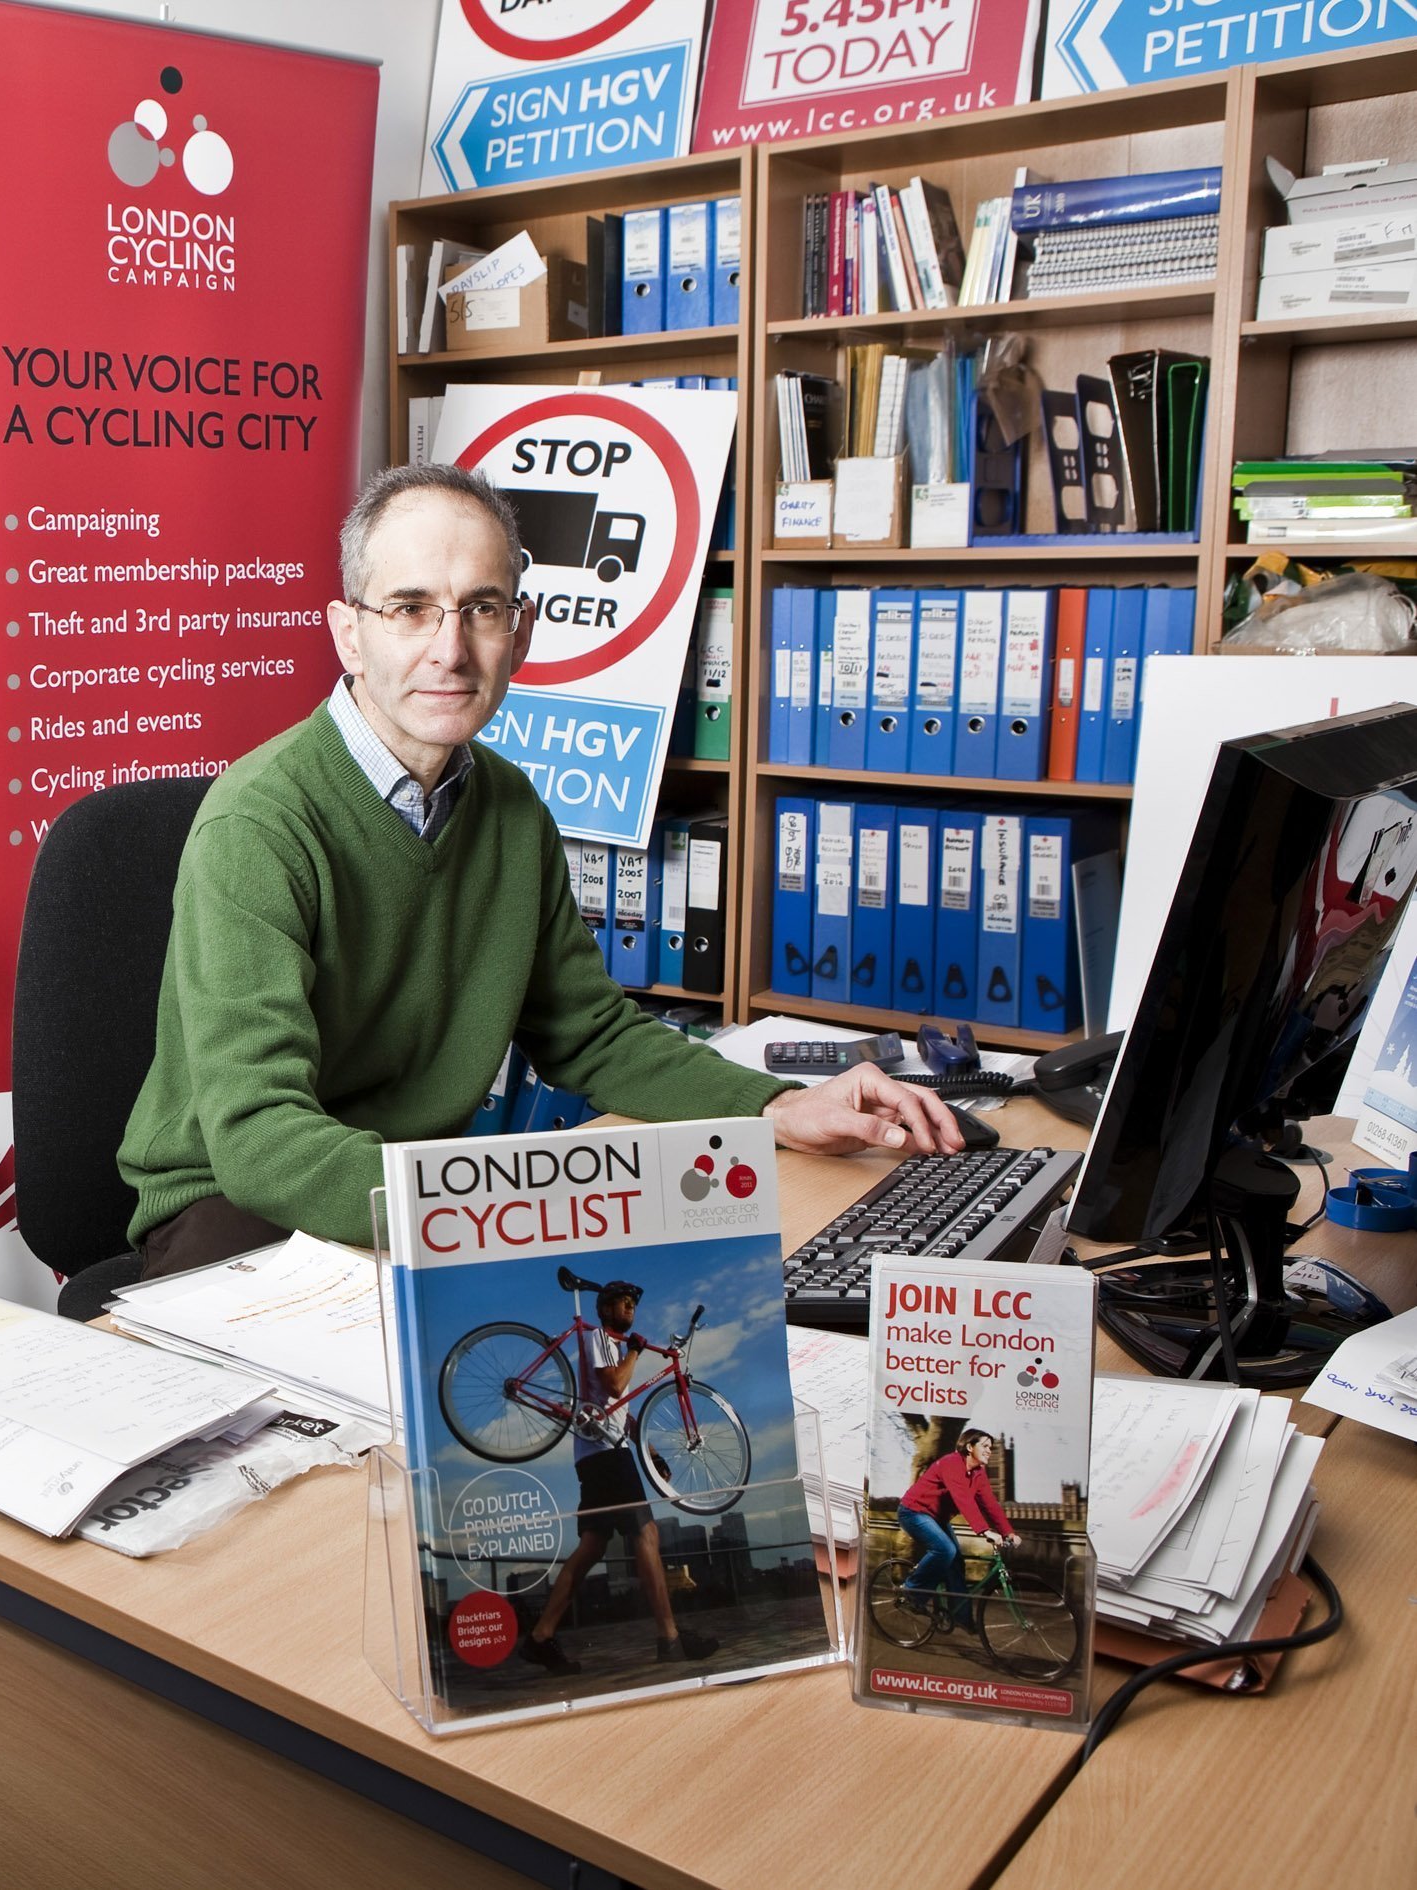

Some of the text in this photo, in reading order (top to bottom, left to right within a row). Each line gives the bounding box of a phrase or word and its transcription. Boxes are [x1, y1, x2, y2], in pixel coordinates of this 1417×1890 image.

[764, 20, 954, 89] TODAY
[491, 63, 672, 128] SIGN HGV
[712, 82, 996, 146] www.lcc.org.uk
[485, 110, 665, 173] PETITION
[107, 203, 235, 243] LONDON
[107, 235, 235, 274] CYCLING
[107, 266, 236, 292] CAMPAIGN
[451, 259, 500, 293] PAYSLIP
[2, 346, 323, 400] YOUR VOICE FOR
[2, 404, 318, 451] A CYCLING CITY
[511, 438, 632, 478] STOP
[27, 505, 160, 538] Campaigning
[28, 556, 304, 587] Great membership packages
[28, 607, 322, 637] Theft and 3rd party insurance
[519, 591, 618, 628] NGER
[29, 655, 295, 693] Corporate cycling services
[30, 711, 202, 741] Rides and events
[477, 709, 642, 762] GN HGV
[30, 756, 229, 797] Cycling information
[513, 760, 631, 812] TION
[619, 855, 644, 868] VAT
[996, 828, 1008, 886] INSURANCE
[582, 873, 604, 885] 2008
[618, 868, 643, 878] 2005
[617, 889, 642, 900] 2007
[1366, 1121, 1387, 1142] 01268
[416, 1142, 641, 1199] LONDON
[421, 1190, 642, 1253] CYCLIST
[681, 1203, 759, 1218] YOUR VOICE FOR
[683, 1213, 759, 1229] A CYCLING CITY
[885, 1283, 1032, 1320] JOIN LCC
[887, 1322, 1055, 1353] make London
[885, 1348, 1006, 1378] better for
[884, 1381, 968, 1407] cyclists
[1015, 1391, 1059, 1401] LONDON
[1015, 1399, 1059, 1409] CYCLING
[1364, 1387, 1394, 1406] YOUR
[274, 1416, 326, 1435] arket
[90, 1466, 194, 1531] ector
[462, 1490, 541, 1517] GO DUTCH
[464, 1510, 552, 1539] PRINCIPLES
[467, 1532, 555, 1560] EXPLAINED
[456, 1610, 501, 1624] Blackfriars
[457, 1622, 503, 1636] Bridge: our
[459, 1637, 491, 1648] designs
[876, 1673, 998, 1700] www.lcc.org.uk
